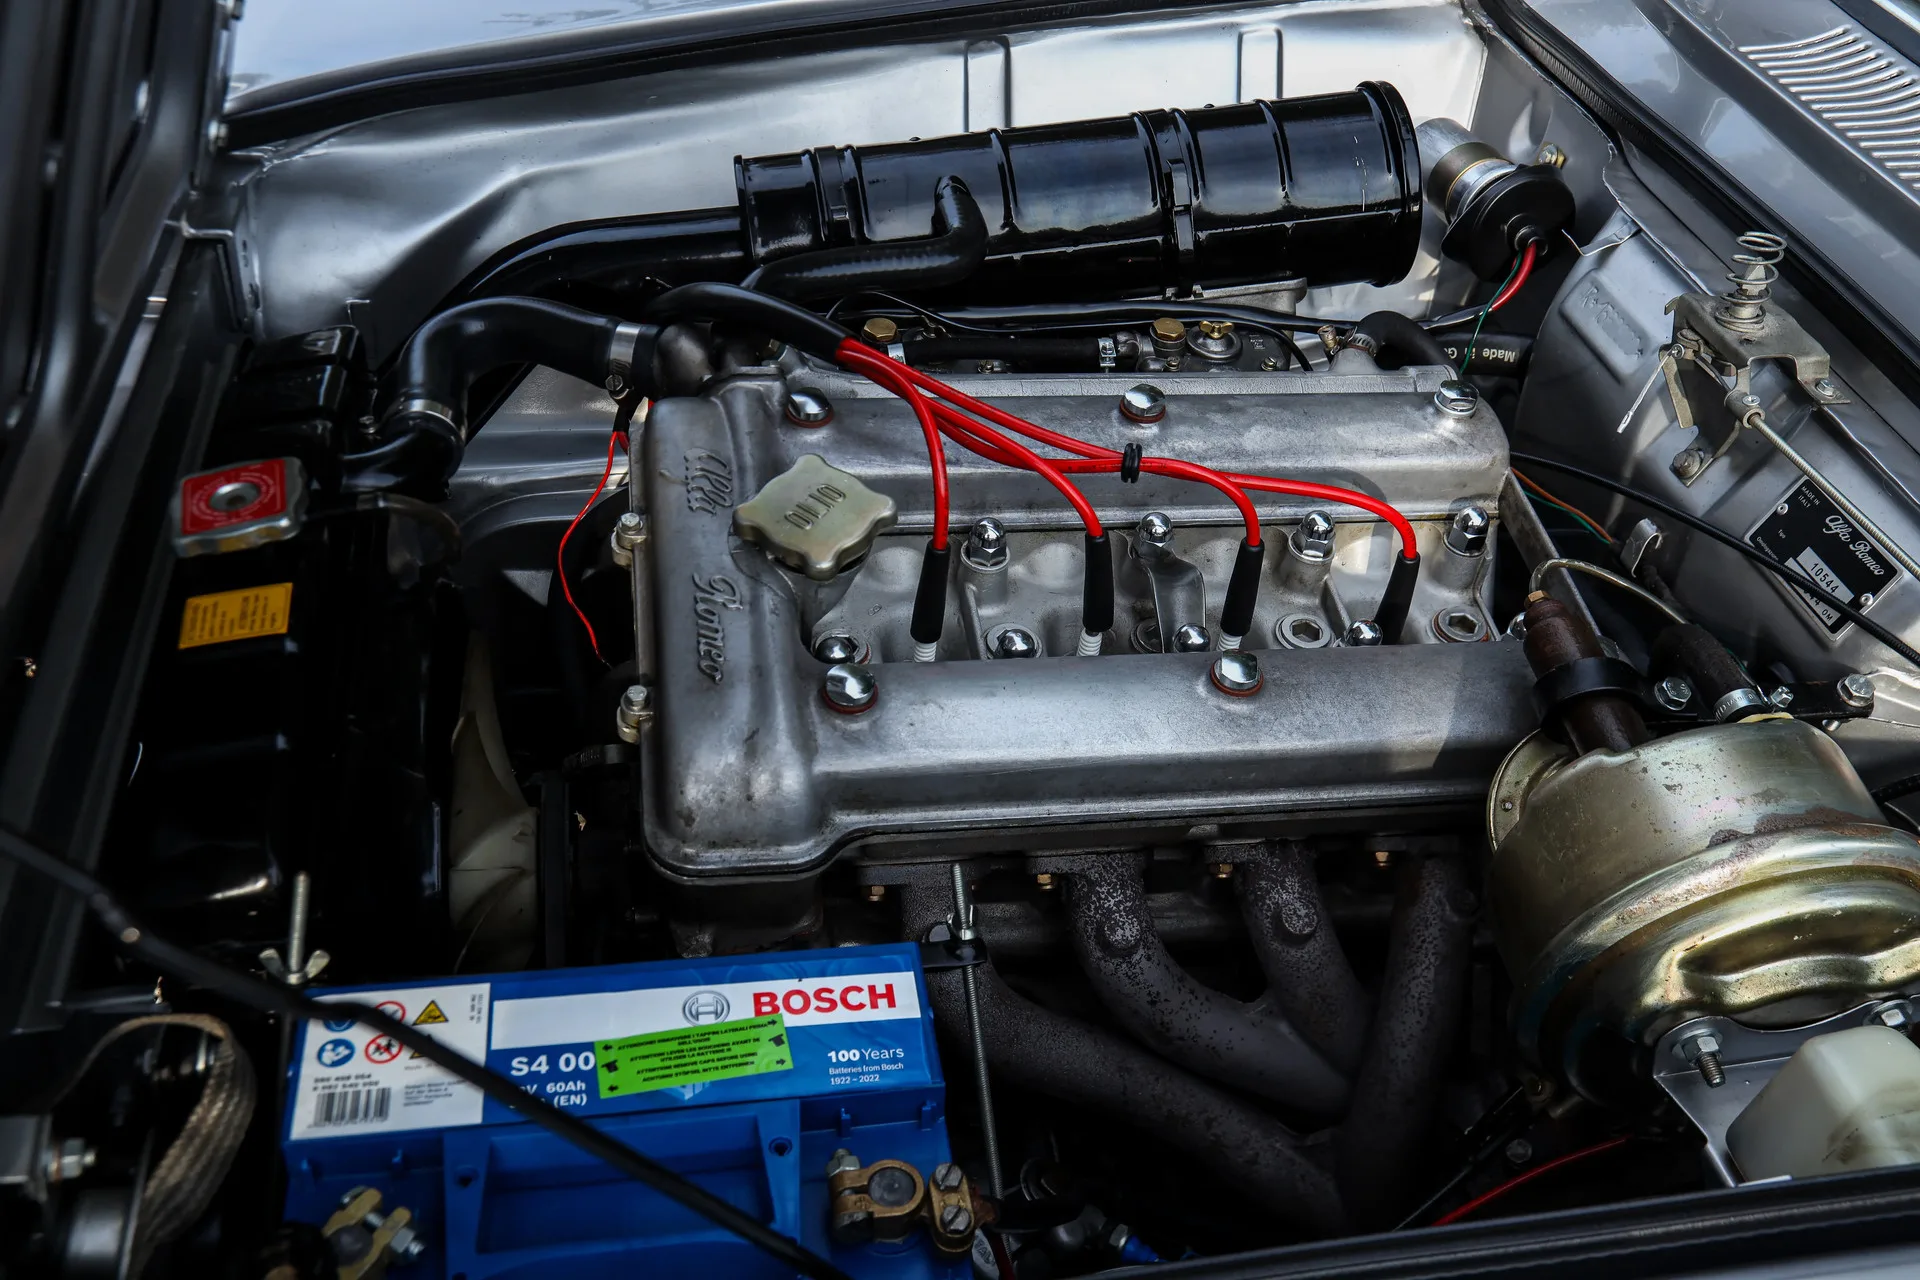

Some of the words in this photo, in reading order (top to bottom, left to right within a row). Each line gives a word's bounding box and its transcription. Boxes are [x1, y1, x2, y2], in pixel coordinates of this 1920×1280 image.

[1483, 348, 1516, 363] Made
[1801, 486, 1815, 500] MADE
[784, 483, 847, 531] OLIO
[1798, 495, 1811, 508] ITALY
[1822, 514, 1851, 543] Alfa
[1849, 540, 1885, 576] Romeo
[1810, 563, 1840, 594] 10544
[692, 572, 743, 684] Romeo
[753, 983, 897, 1018] BOSCH
[827, 1049, 860, 1063] 100
[861, 1048, 905, 1060] Years
[510, 1054, 550, 1076] S4
[829, 1065, 862, 1075] Batteries
[863, 1064, 880, 1072] from
[881, 1062, 904, 1071] Bosch
[546, 1080, 586, 1094] 60Ah
[830, 1076, 851, 1086] 1922
[859, 1074, 880, 1083] 2022
[553, 1093, 588, 1109] (EN)
